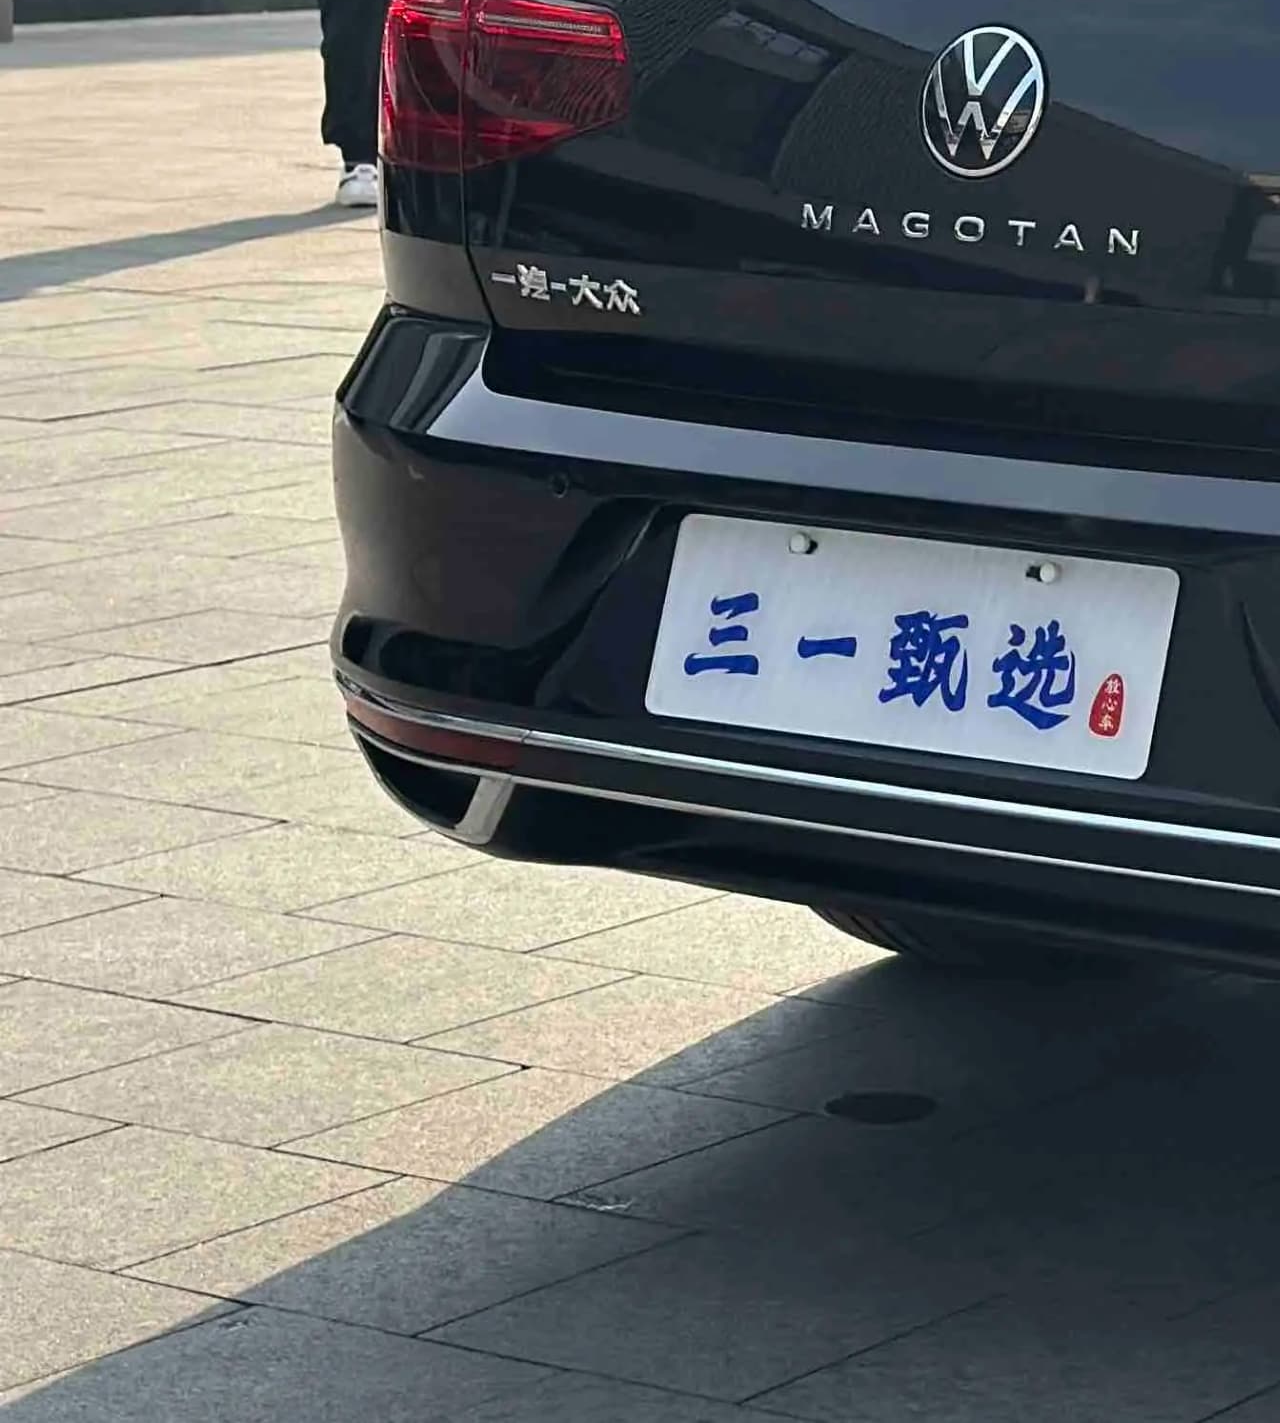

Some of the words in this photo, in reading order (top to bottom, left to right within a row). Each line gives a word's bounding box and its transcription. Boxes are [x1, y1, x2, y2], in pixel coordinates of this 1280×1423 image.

[923, 26, 1045, 177] VW
[801, 203, 1140, 255] MAGOTAN
[684, 592, 1075, 730] 三一甄选
